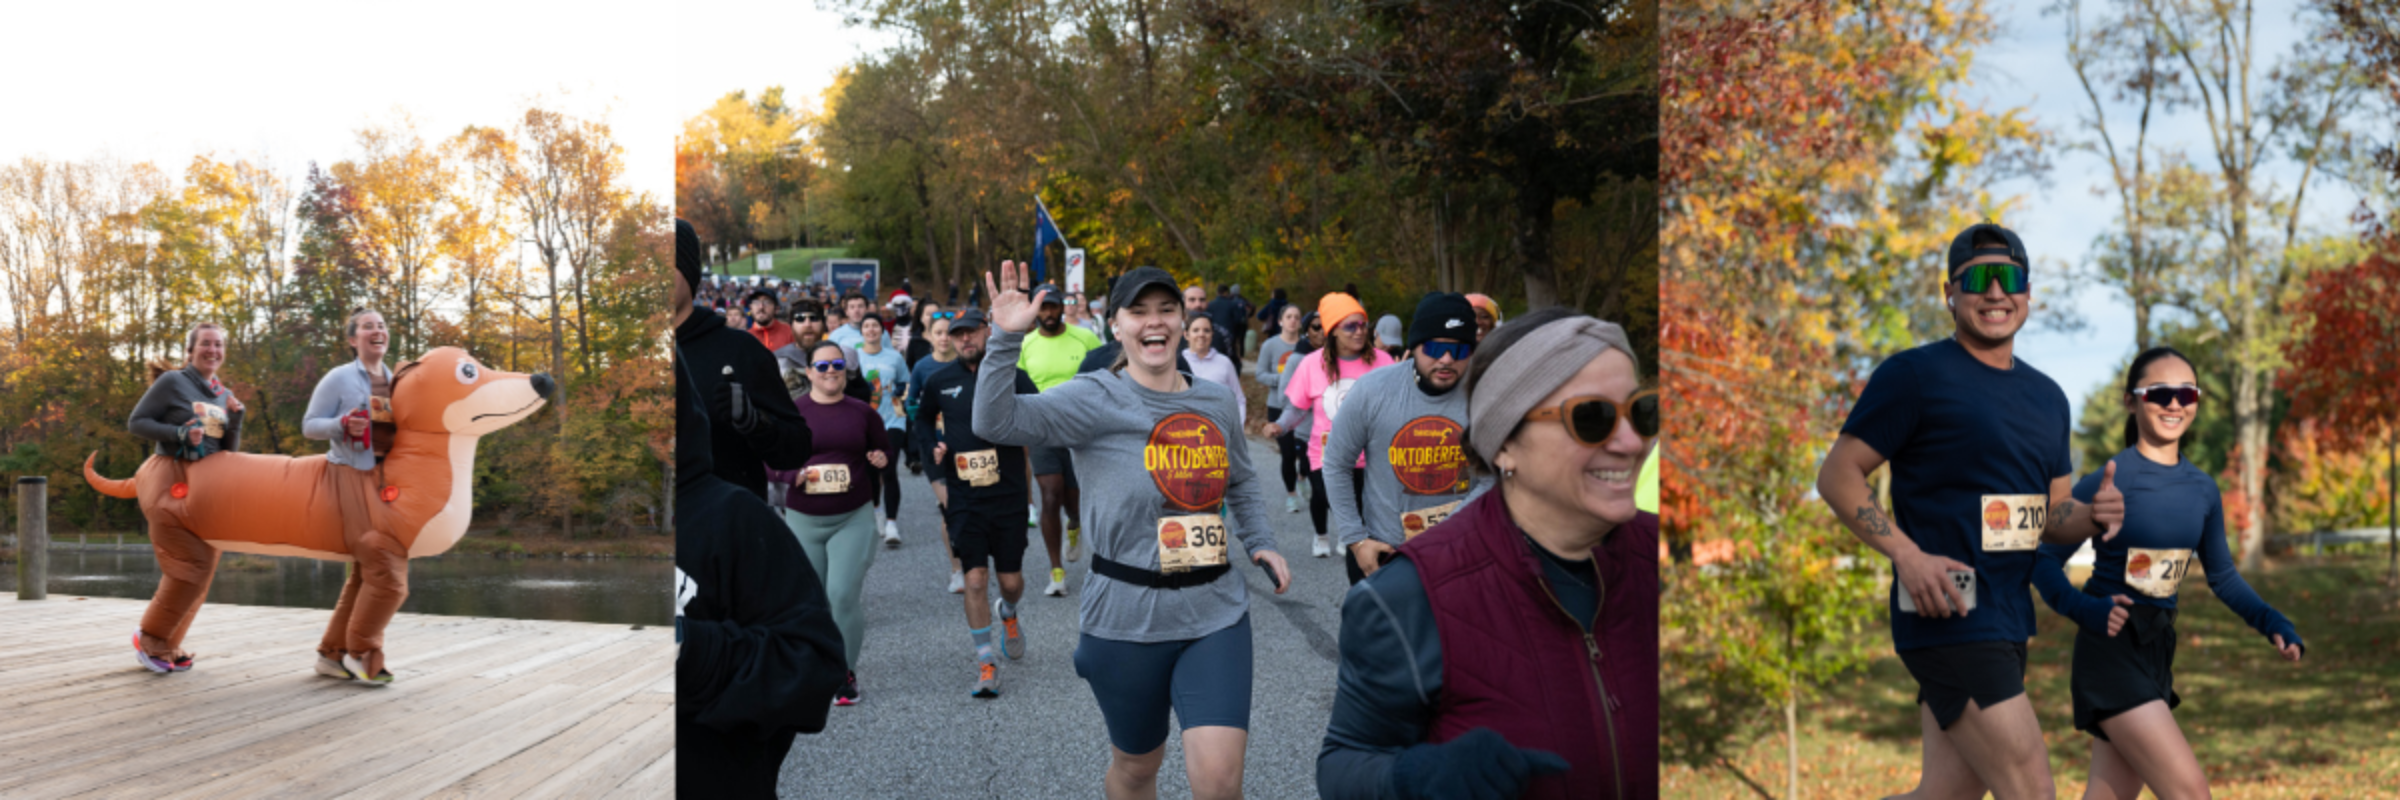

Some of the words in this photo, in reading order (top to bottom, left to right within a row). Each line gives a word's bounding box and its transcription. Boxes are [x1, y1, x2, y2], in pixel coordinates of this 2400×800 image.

[969, 455, 996, 470] 634
[824, 469, 846, 482] 613
[2017, 505, 2045, 530] 210
[1191, 525, 1225, 547] 362
